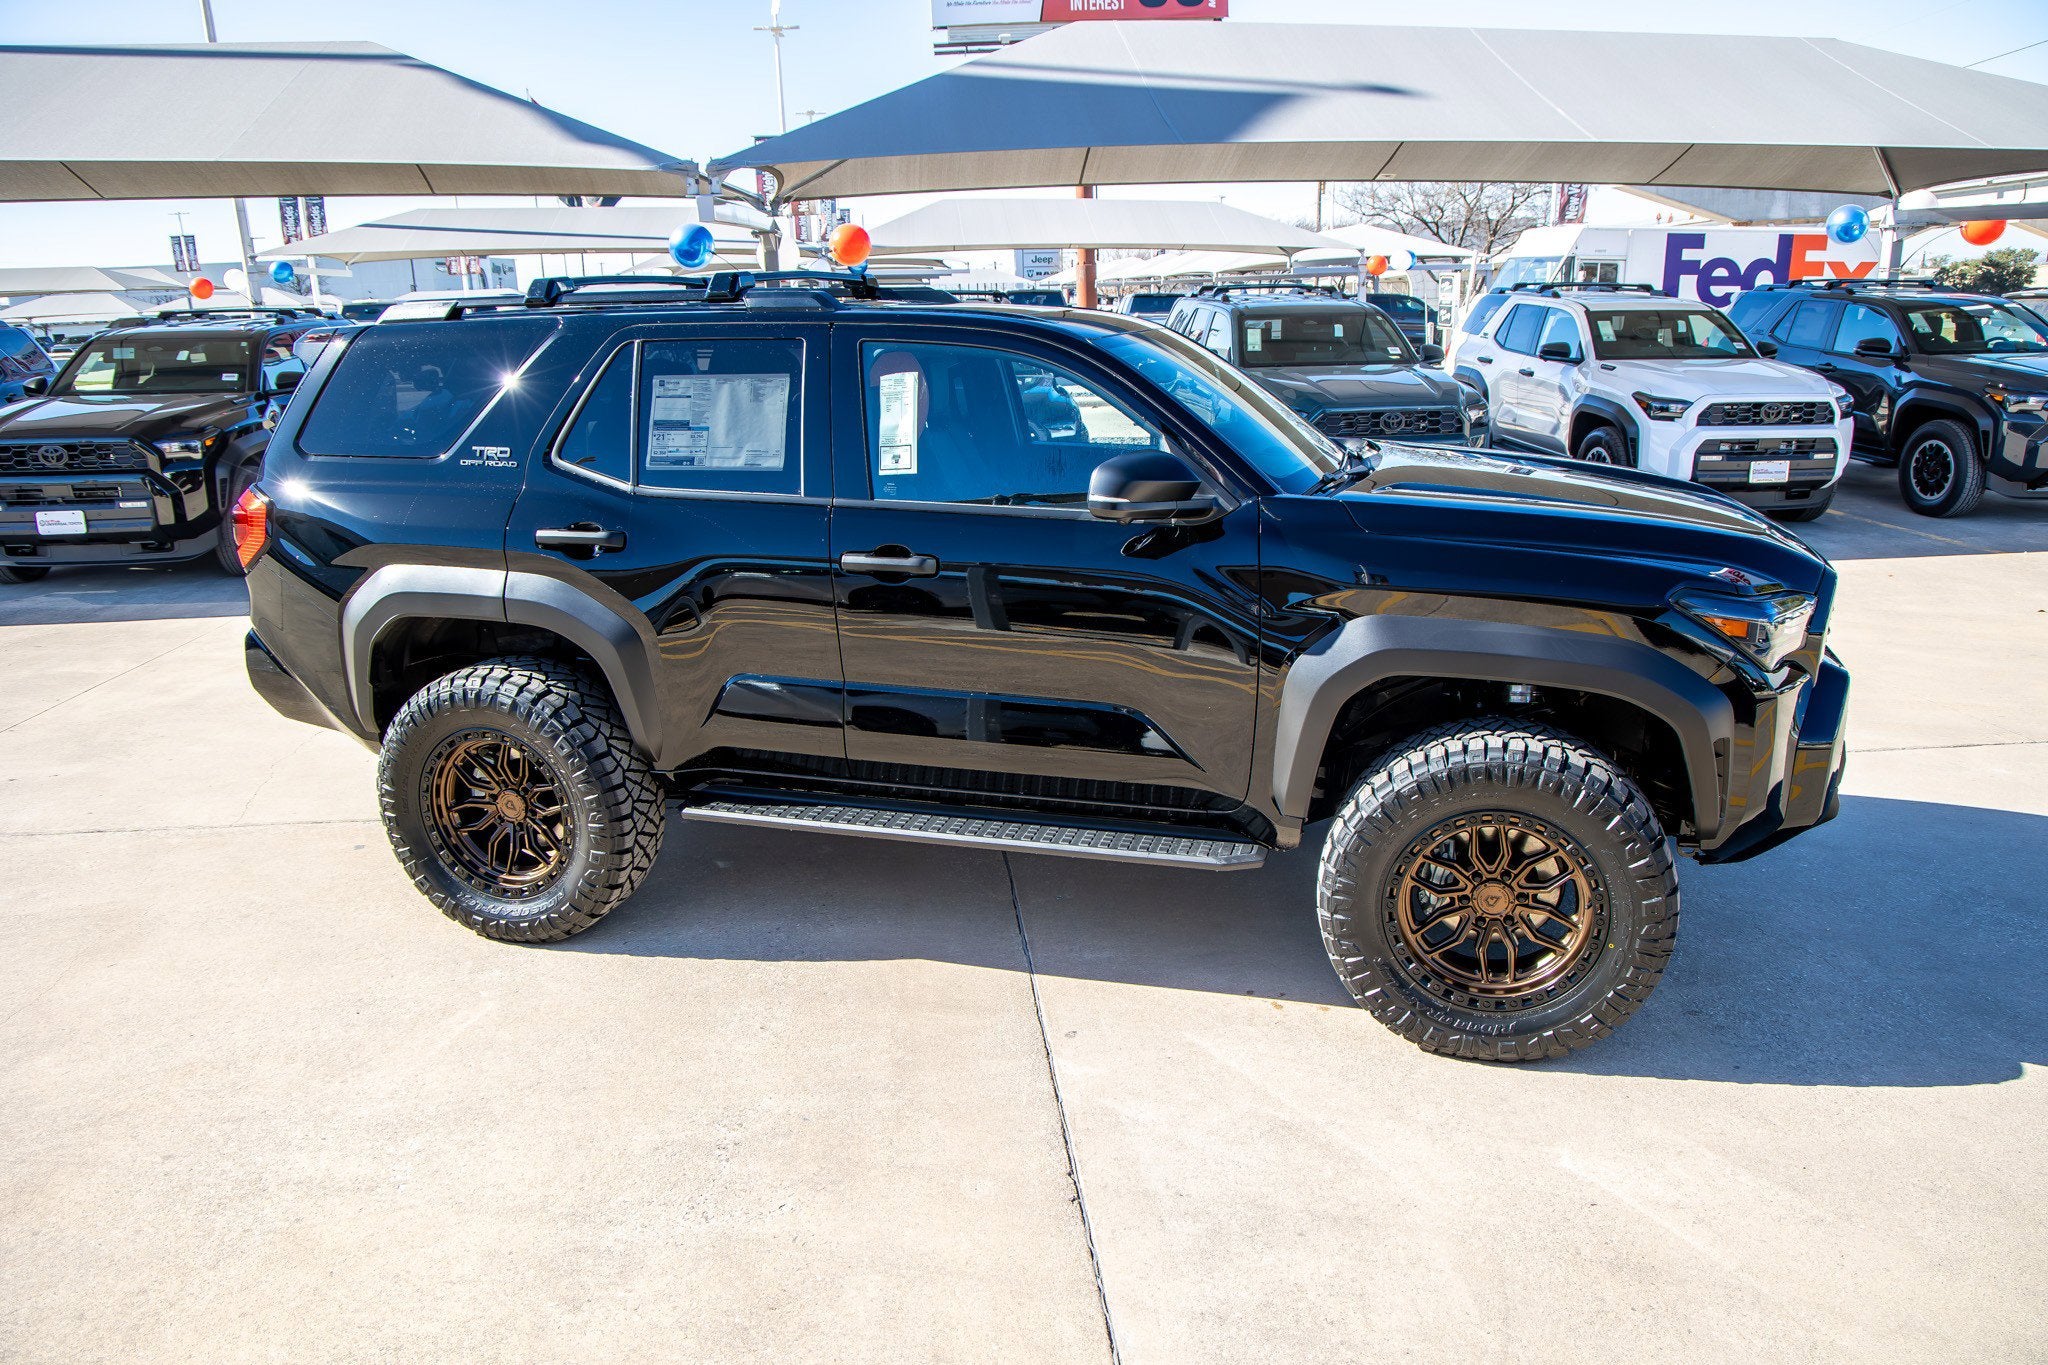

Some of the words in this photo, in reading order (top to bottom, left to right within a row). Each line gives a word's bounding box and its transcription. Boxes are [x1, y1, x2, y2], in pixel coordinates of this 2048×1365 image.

[1565, 196, 1580, 220] New
[1031, 255, 1053, 264] Jeep
[472, 446, 510, 460] TRD
[484, 460, 518, 468] ROAD
